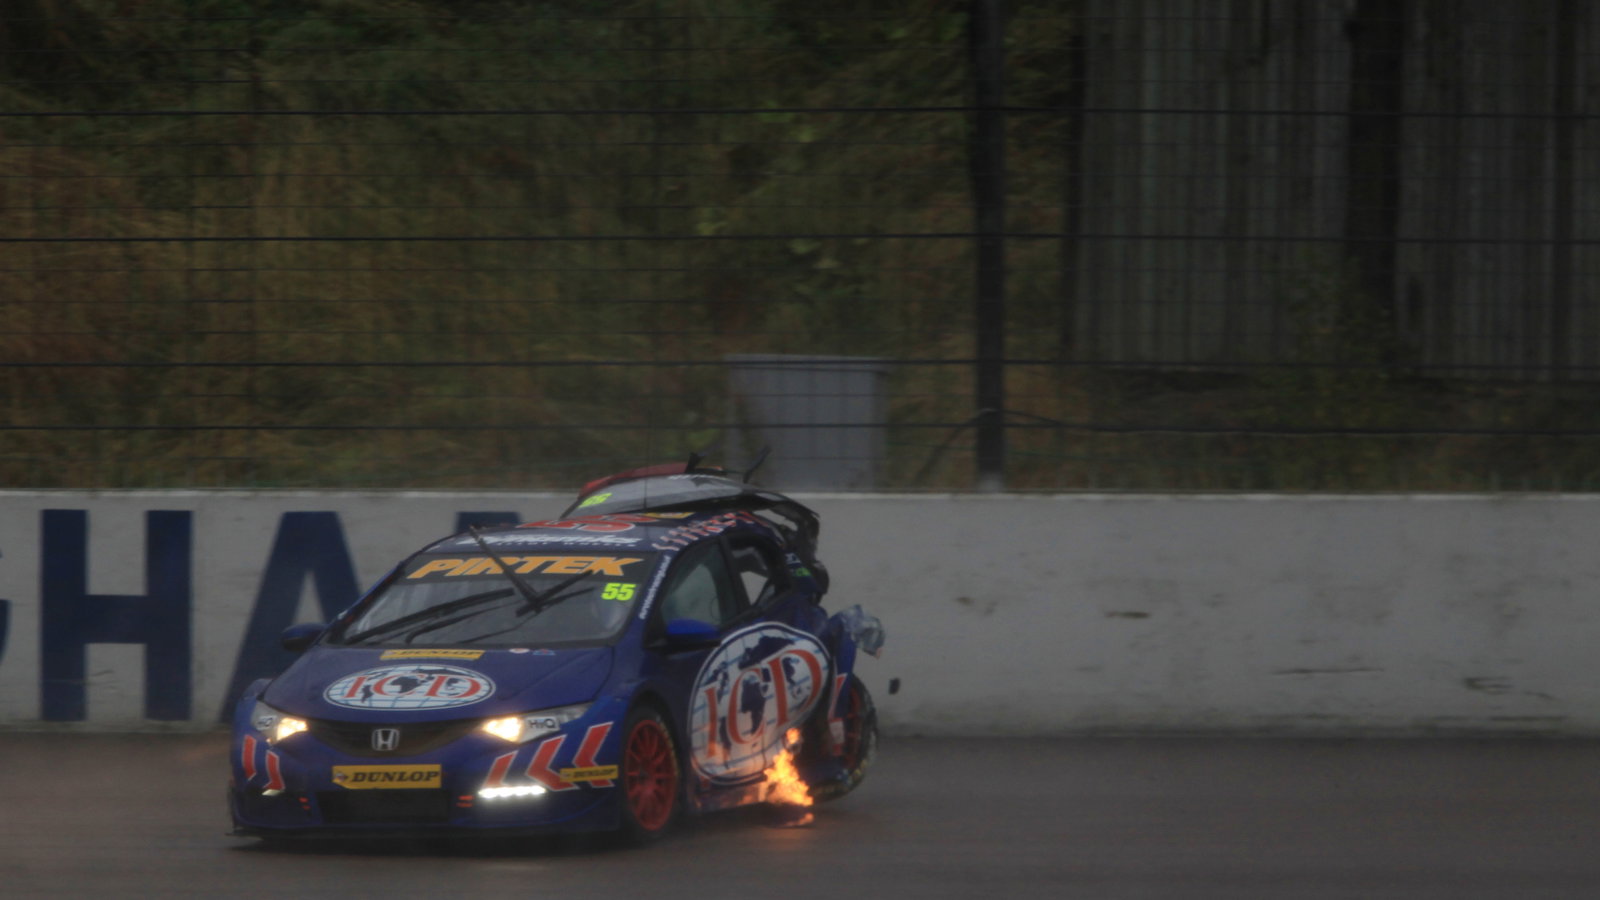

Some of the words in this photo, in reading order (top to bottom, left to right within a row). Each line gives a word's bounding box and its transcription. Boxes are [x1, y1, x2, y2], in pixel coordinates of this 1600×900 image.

[407, 556, 643, 579] PIRTEK
[601, 583, 636, 602] 55
[345, 675, 481, 700] ICD
[704, 649, 823, 759] ICD
[353, 771, 439, 783] DUNLOP
